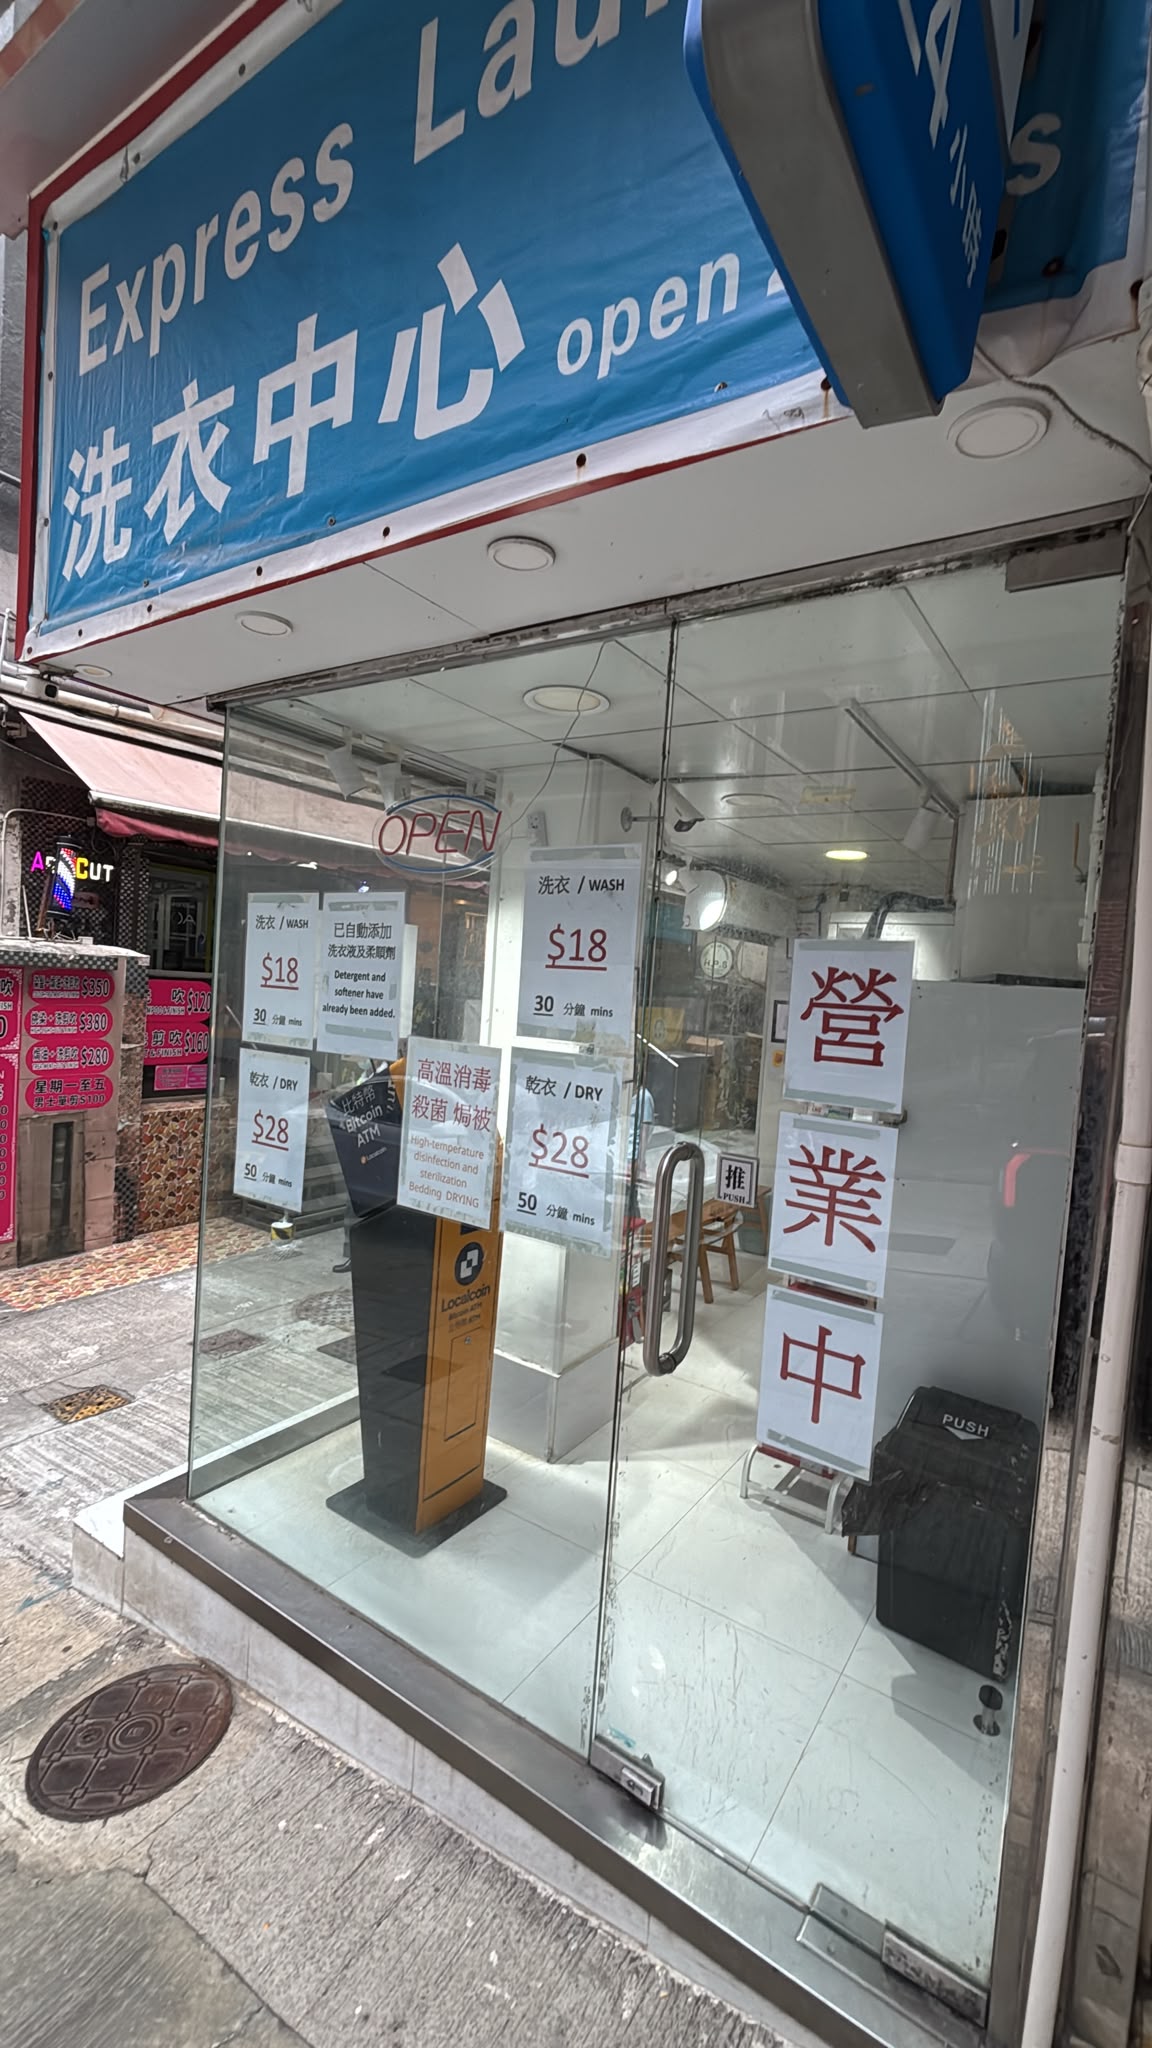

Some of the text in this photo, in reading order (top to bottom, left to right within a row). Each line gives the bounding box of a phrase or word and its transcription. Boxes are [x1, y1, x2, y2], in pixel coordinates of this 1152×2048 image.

[79, 122, 354, 377] Express
[556, 253, 739, 380] open
[62, 243, 526, 581] 洗衣中心
[378, 810, 502, 856] OPEN
[538, 875, 625, 895] 洗衣 / WASH
[256, 915, 309, 930] 洗衣 / WASH
[334, 922, 392, 939] 已自動添加
[547, 923, 607, 965] $18
[262, 952, 299, 984] $18
[335, 970, 386, 982] Detergent and
[81, 977, 110, 997] $350
[172, 988, 185, 1003] 吹
[335, 987, 384, 999] softener have
[254, 1008, 267, 1022] 30
[289, 1015, 302, 1026] mins
[322, 1004, 396, 1018] already been added.
[534, 995, 614, 1018] 30 分鐘 mins
[80, 1012, 107, 1031] $380
[185, 1031, 208, 1054] $160
[81, 1047, 108, 1066] $280
[35, 1079, 105, 1094] 星期一至五
[250, 1071, 298, 1091] 乾衣 / DRY
[418, 1058, 491, 1093] 高溫消毒
[525, 1075, 604, 1102] 乾衣 / DRY
[346, 1105, 382, 1133] Bitcoin
[412, 1095, 448, 1123] 殺菌
[253, 1109, 288, 1144] $28
[358, 1124, 380, 1147] ATM
[411, 1135, 484, 1160] High-temperature
[531, 1123, 589, 1169] $28
[414, 1151, 478, 1175] disinfection and
[244, 1163, 257, 1177] 50
[278, 1178, 292, 1188] mins
[420, 1168, 467, 1188] sterilization
[725, 1165, 745, 1190] 推
[409, 1181, 479, 1208] Bedding DRYING
[723, 1192, 745, 1204] PUSH
[518, 1191, 537, 1211] 50
[572, 1212, 595, 1226] mins
[441, 1284, 491, 1312] Localcoin
[943, 1413, 989, 1437] PUSH
